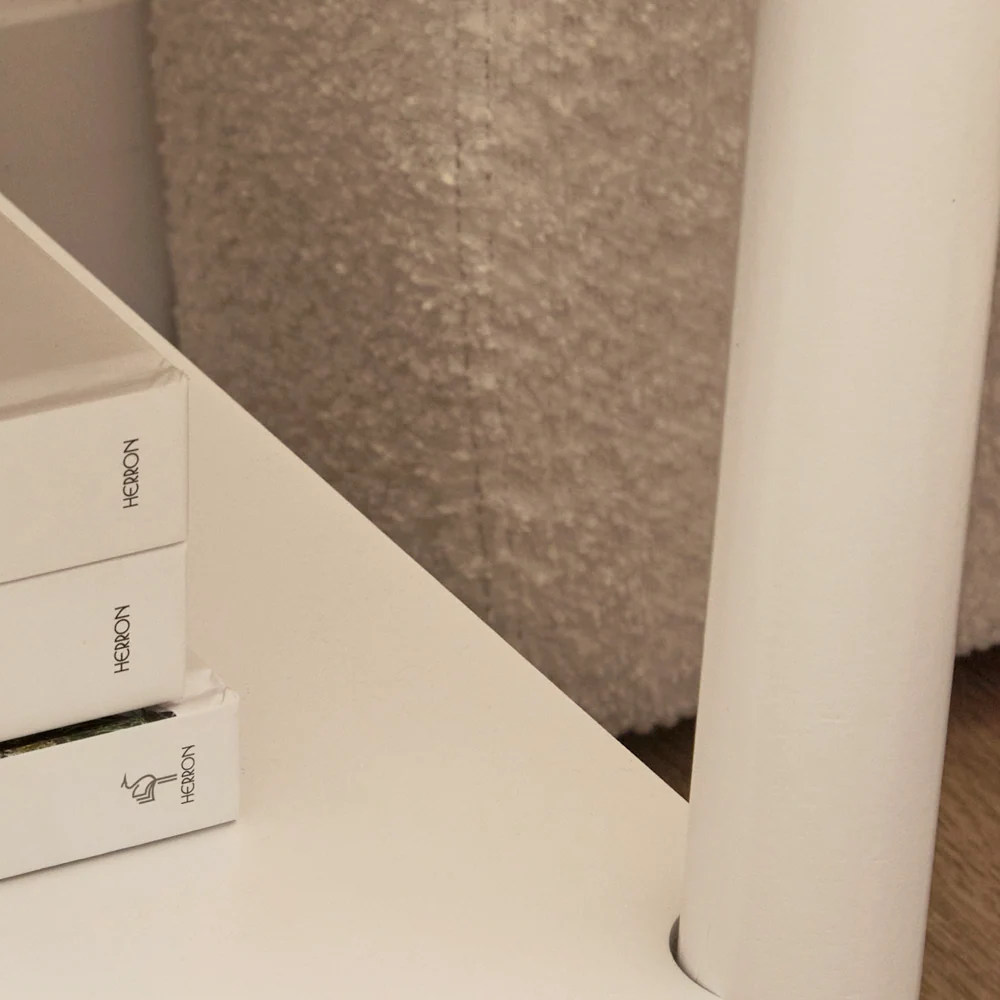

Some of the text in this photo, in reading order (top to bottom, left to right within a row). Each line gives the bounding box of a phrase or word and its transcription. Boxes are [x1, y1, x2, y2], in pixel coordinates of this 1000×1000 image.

[122, 438, 140, 509] HERRON
[114, 604, 131, 674] HERRON
[181, 744, 196, 805] HERRON
